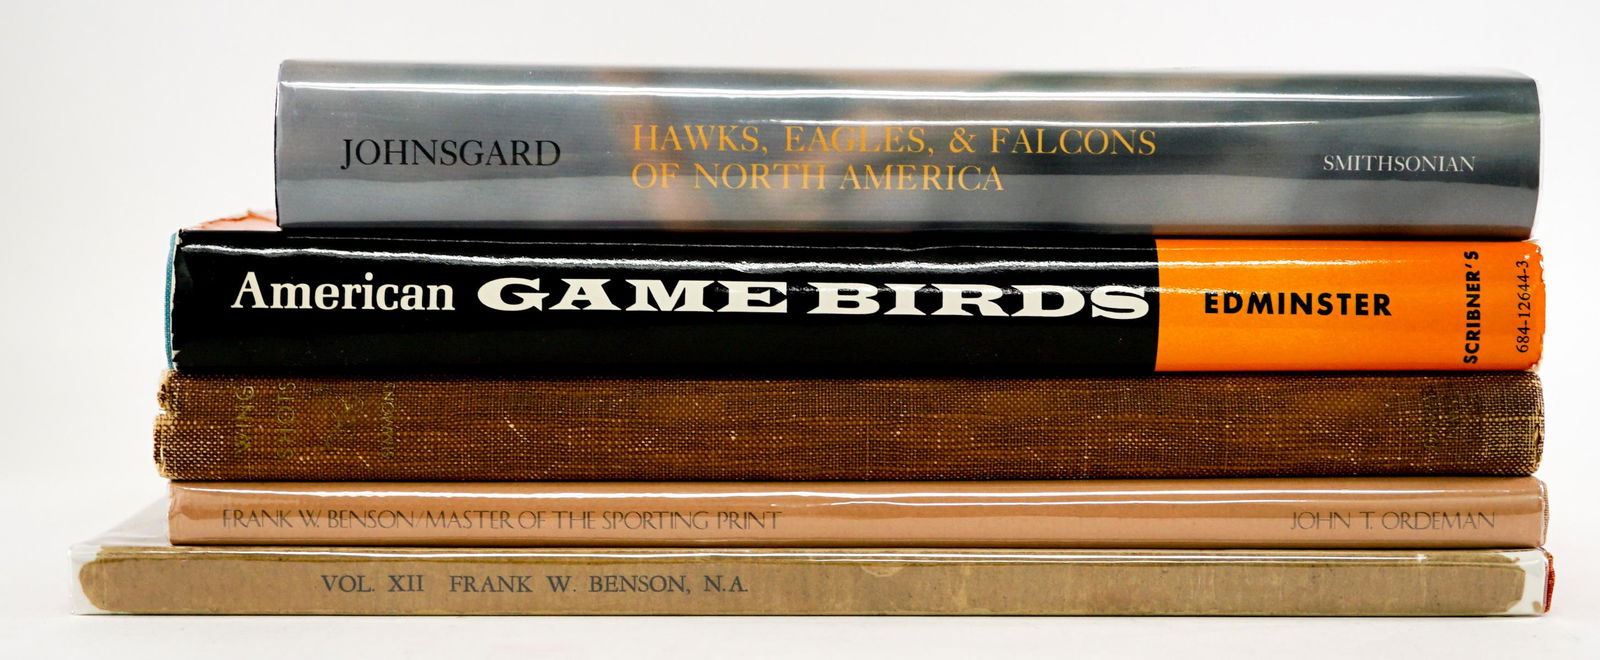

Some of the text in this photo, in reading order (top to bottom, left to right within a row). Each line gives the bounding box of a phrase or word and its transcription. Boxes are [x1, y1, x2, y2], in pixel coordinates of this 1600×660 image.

[340, 137, 561, 171] JOHNSGARD
[632, 124, 1157, 157] HAWKS, EAGLES, & FALCONS
[631, 162, 1005, 192] OF NORTH AMERICA
[1322, 154, 1477, 174] SMITHSONIAN
[230, 271, 1150, 320] American GAME BIRDS
[1203, 292, 1393, 317] EDMINSTER
[1463, 250, 1481, 364] SCRIBNER'S
[1515, 260, 1531, 353] 684-12644-3
[235, 385, 254, 455] WING
[277, 381, 295, 459] SHOTS
[222, 508, 294, 528] FRANK
[299, 509, 321, 528] W.
[518, 511, 547, 529] OF
[551, 511, 596, 529] THE
[602, 511, 709, 530] SPORTING
[717, 511, 782, 530] PRINT
[1290, 511, 1496, 531] JOHN T. ORDEMAN
[321, 574, 375, 593] VOL.
[387, 574, 425, 592] XII
[449, 574, 533, 593] FRANK
[546, 575, 577, 593] W.
[588, 575, 691, 595] BENSON,
